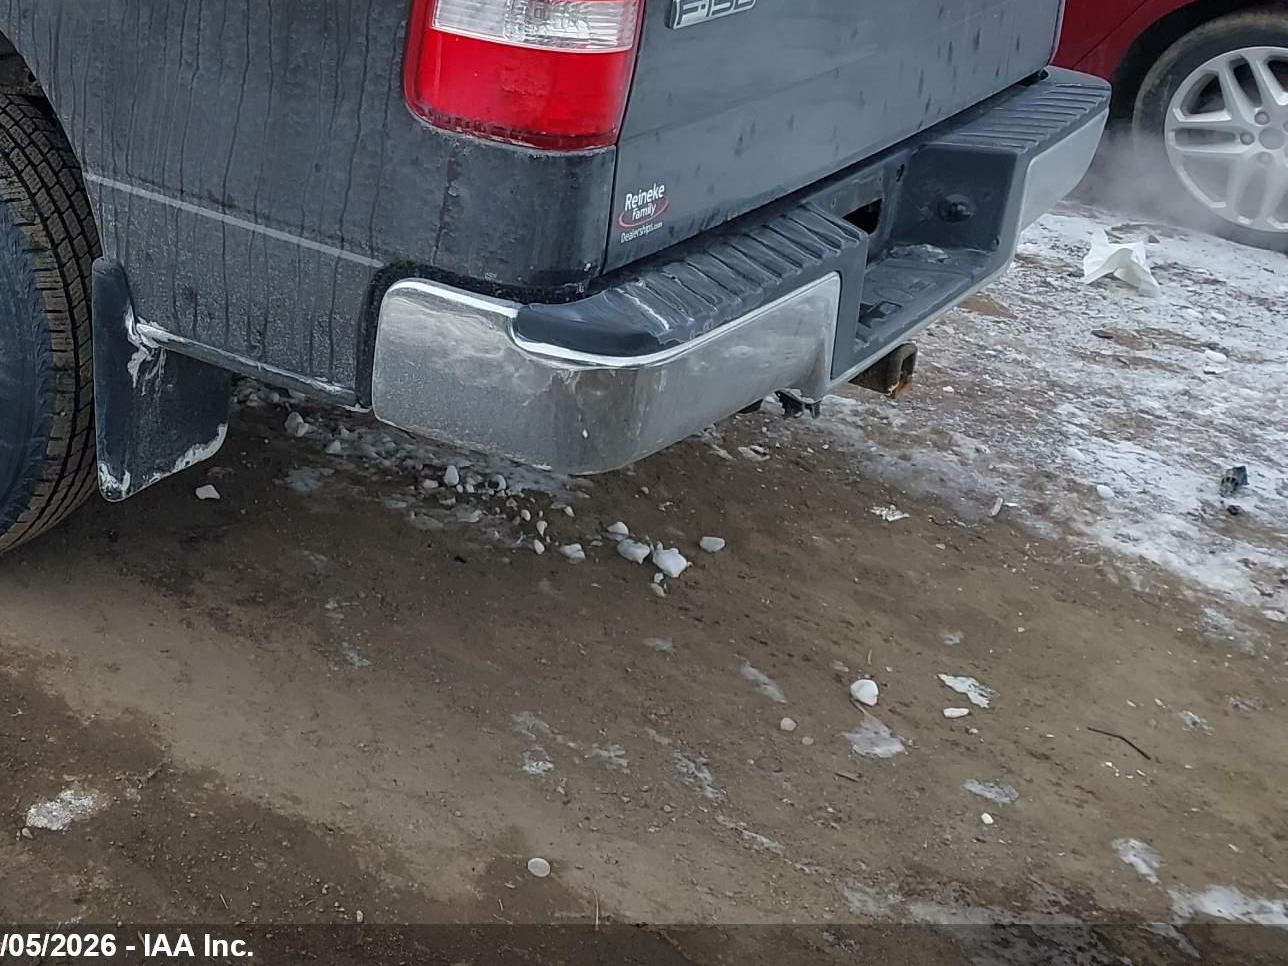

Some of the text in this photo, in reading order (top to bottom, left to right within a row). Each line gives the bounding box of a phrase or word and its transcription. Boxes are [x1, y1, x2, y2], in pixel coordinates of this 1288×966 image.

[625, 183, 665, 212] Reineke
[632, 203, 657, 221] Family
[620, 222, 663, 243] Dealerships.com
